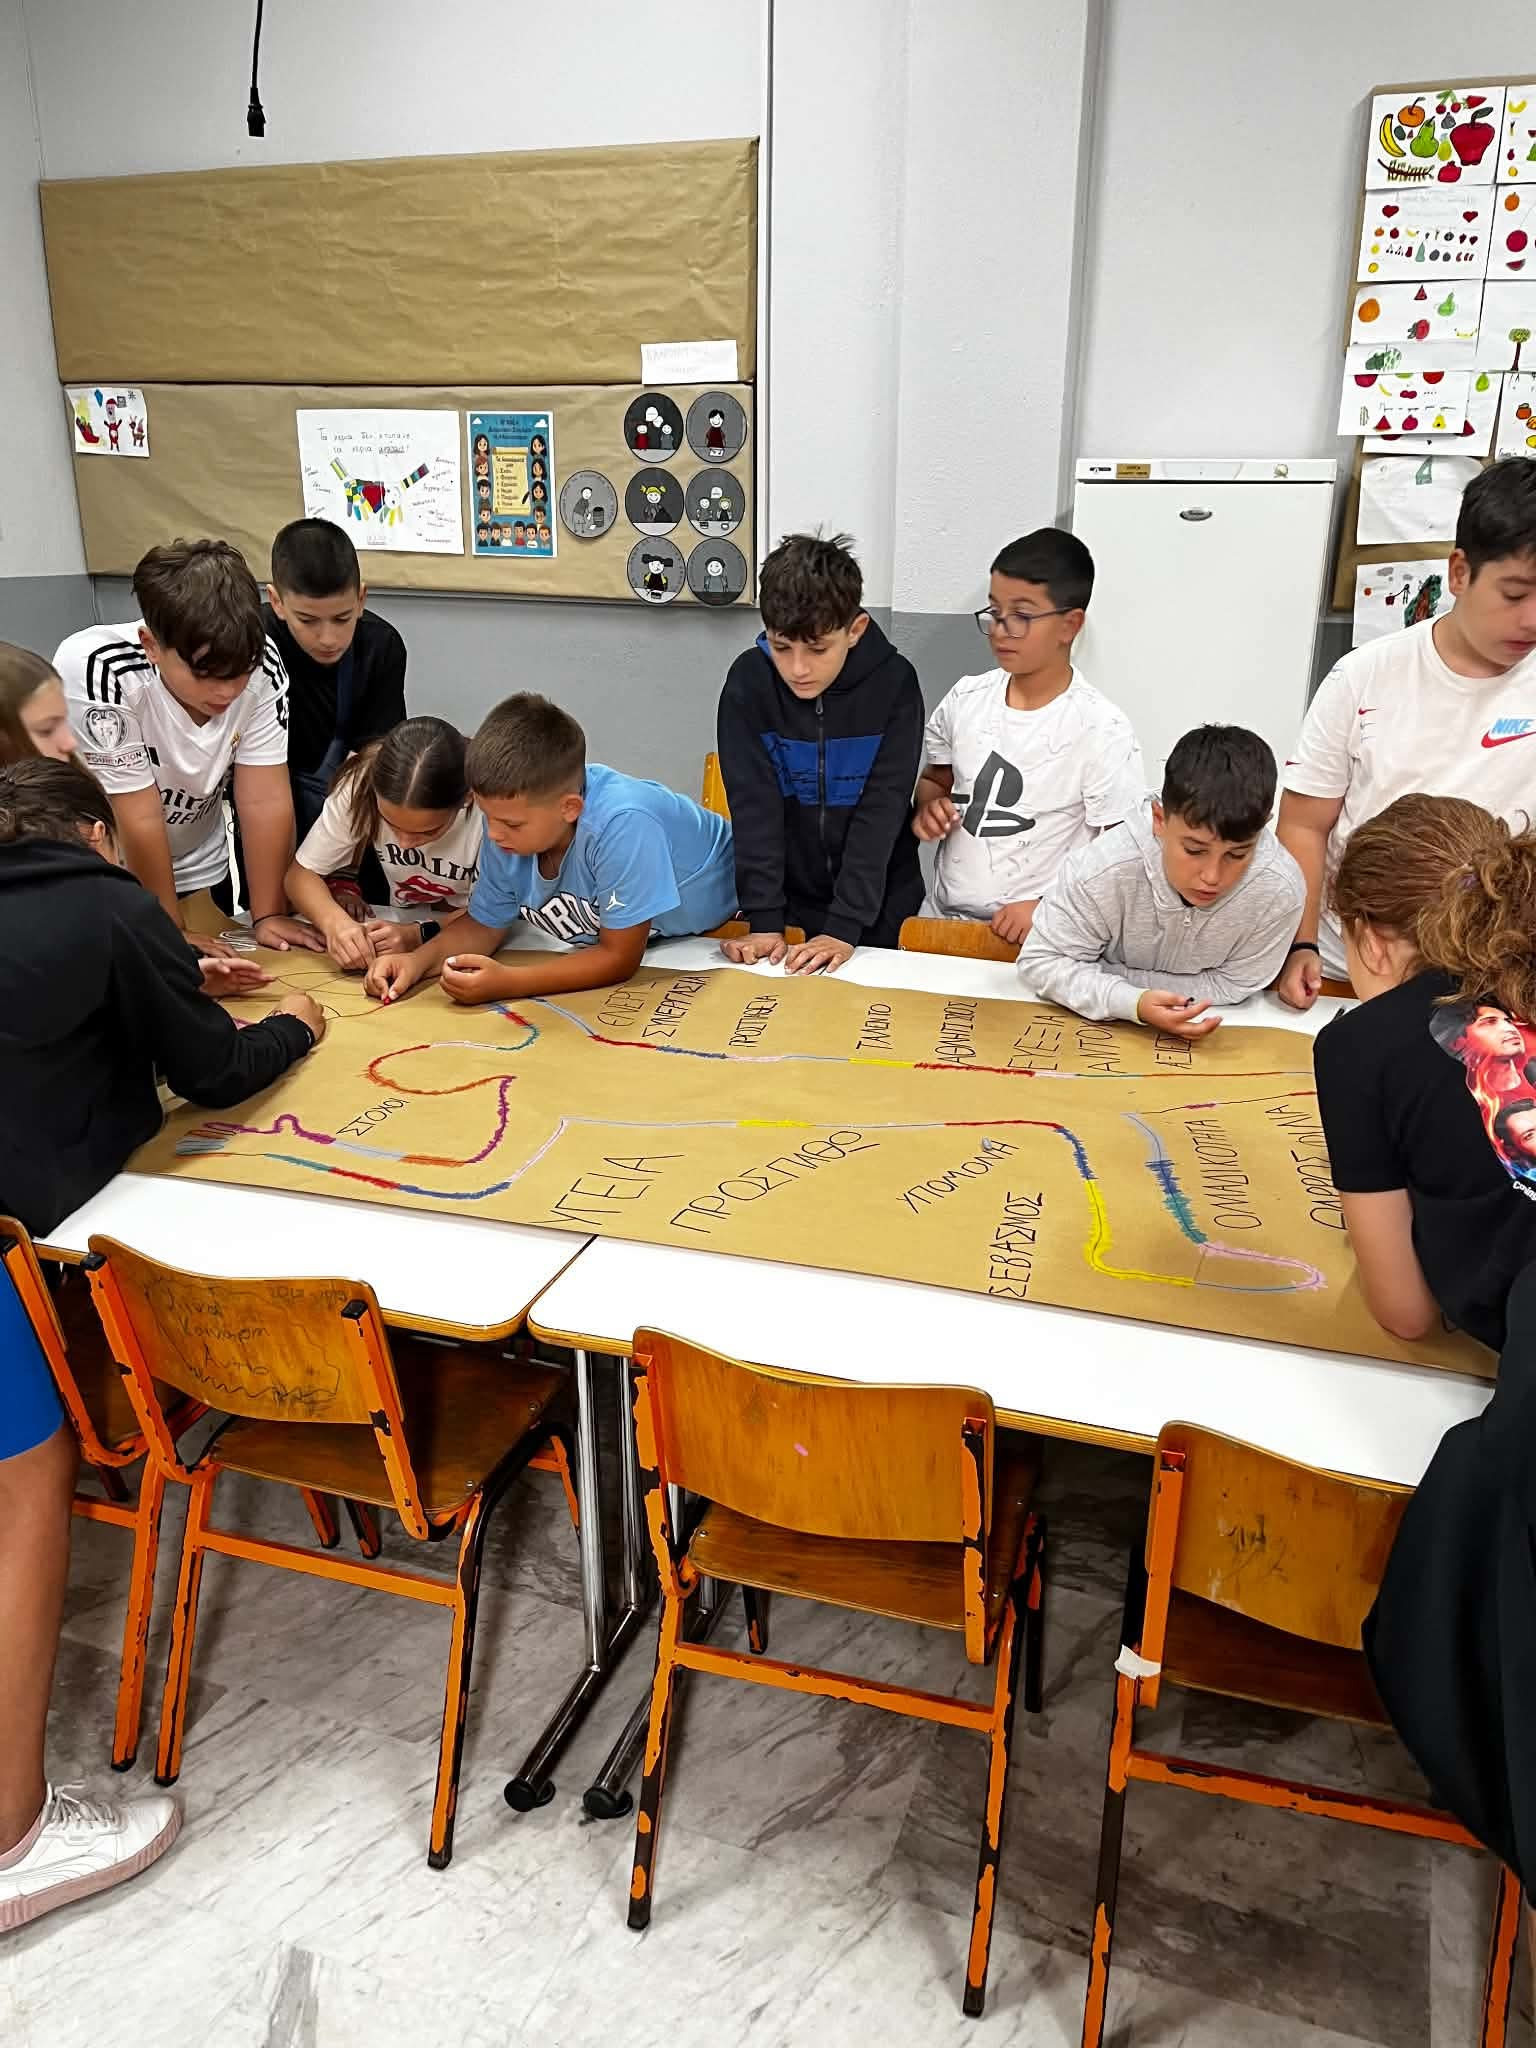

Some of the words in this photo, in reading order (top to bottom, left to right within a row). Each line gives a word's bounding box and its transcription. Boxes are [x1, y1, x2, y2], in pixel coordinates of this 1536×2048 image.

[1490, 717, 1535, 735] NIKE
[384, 843, 480, 883] ROLLIN
[1007, 1015, 1067, 1071] ΕΥΕΞΙΑ
[1075, 1021, 1128, 1074] ΑΝΤΟΧ
[895, 1139, 1020, 1215] ΥΠΟΜΟΝΗ
[1183, 1119, 1262, 1229] ΟΜΑΔΙΚΟΤΗΤΑ
[988, 1191, 1043, 1298] ΣΕΒΑΣΜΟΣ
